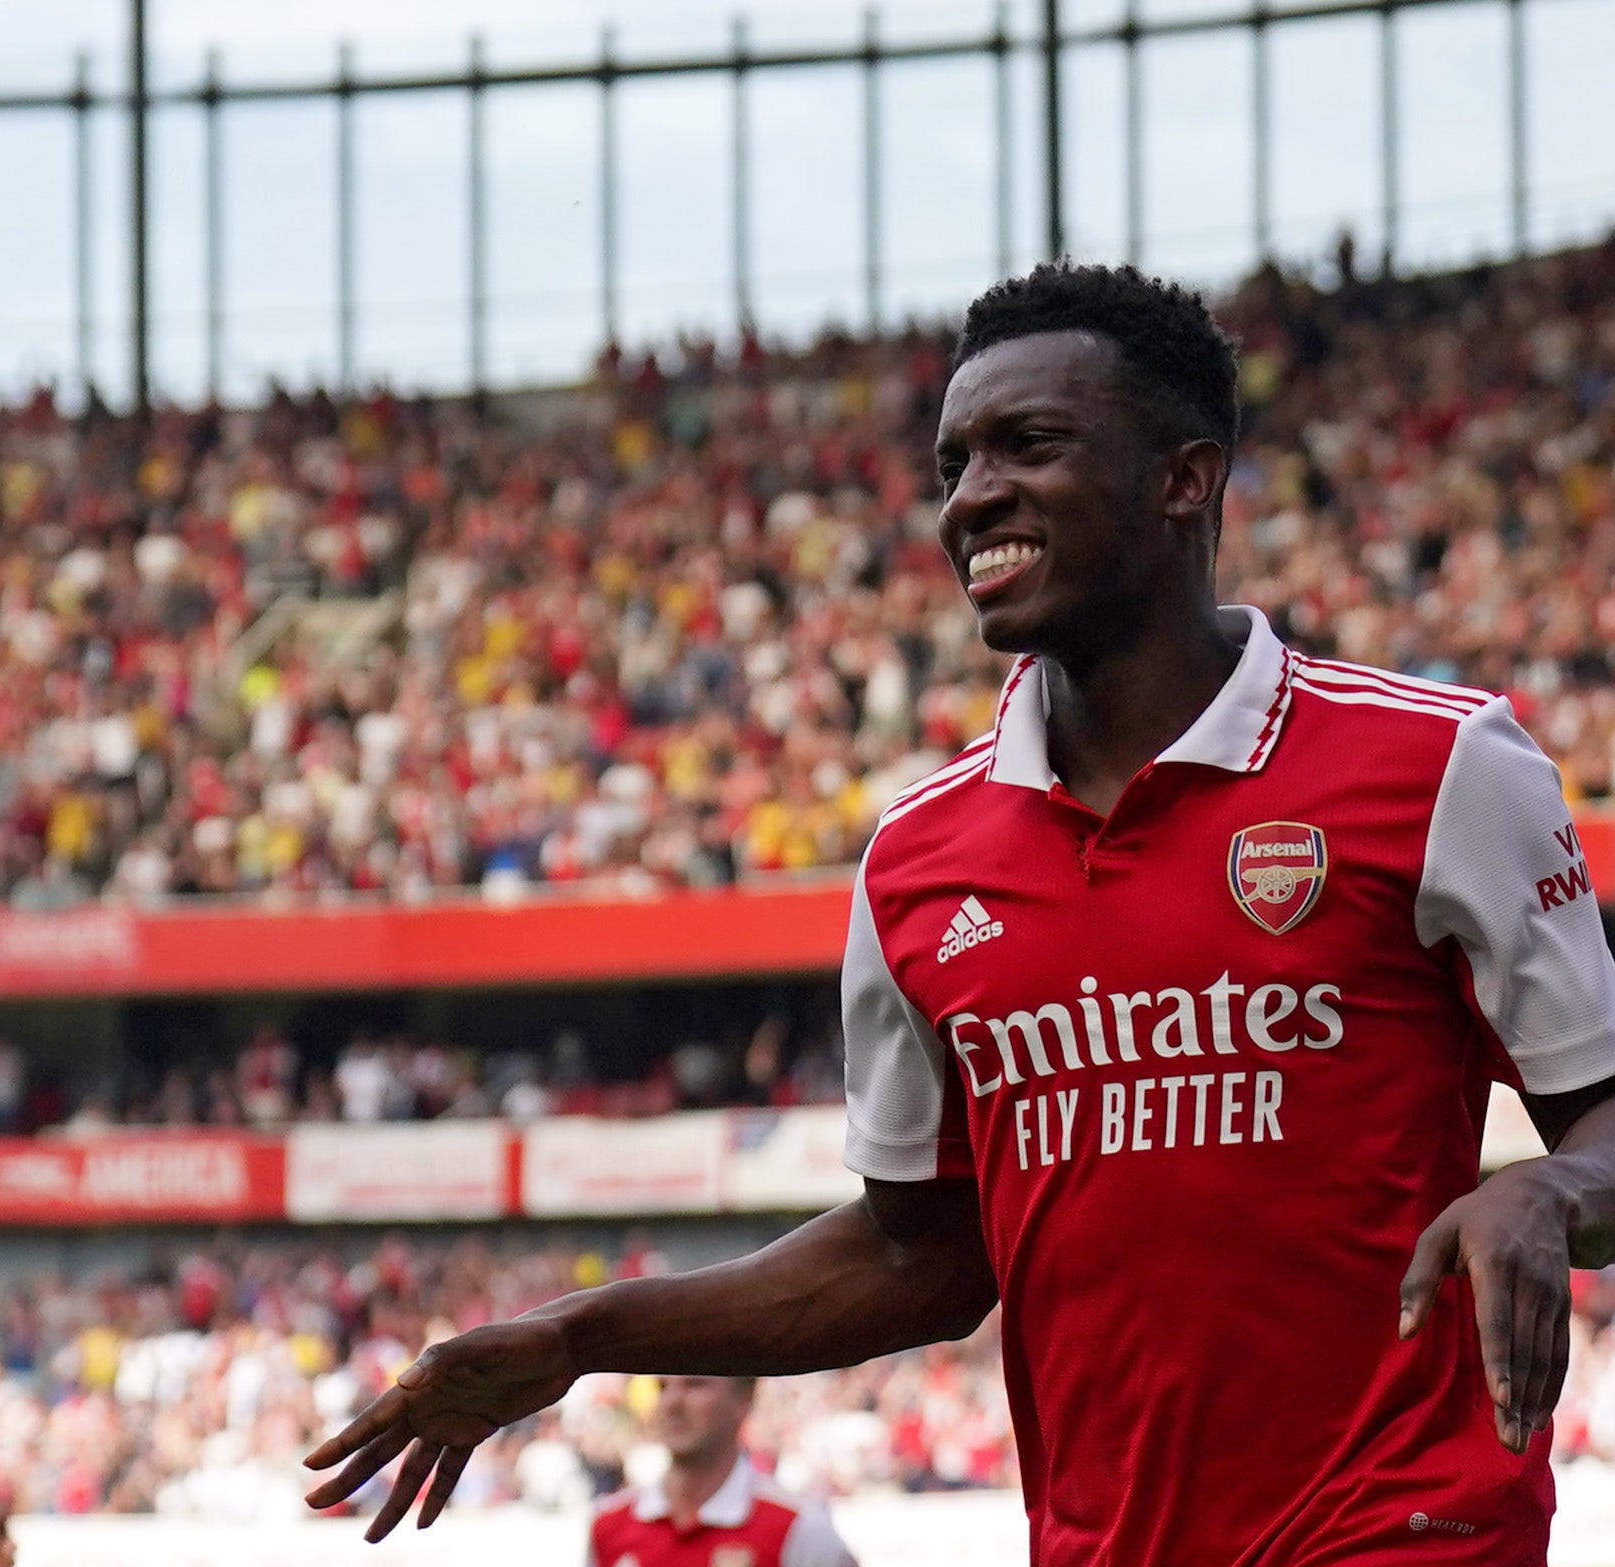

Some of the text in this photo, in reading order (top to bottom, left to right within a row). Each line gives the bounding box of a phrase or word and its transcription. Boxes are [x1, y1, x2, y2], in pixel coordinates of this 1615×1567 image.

[1241, 839, 1313, 859] Arsenal
[937, 921, 1004, 964] adidas
[946, 969, 1344, 1098] Emirates
[1015, 1070, 1285, 1171] FLY BETTER
